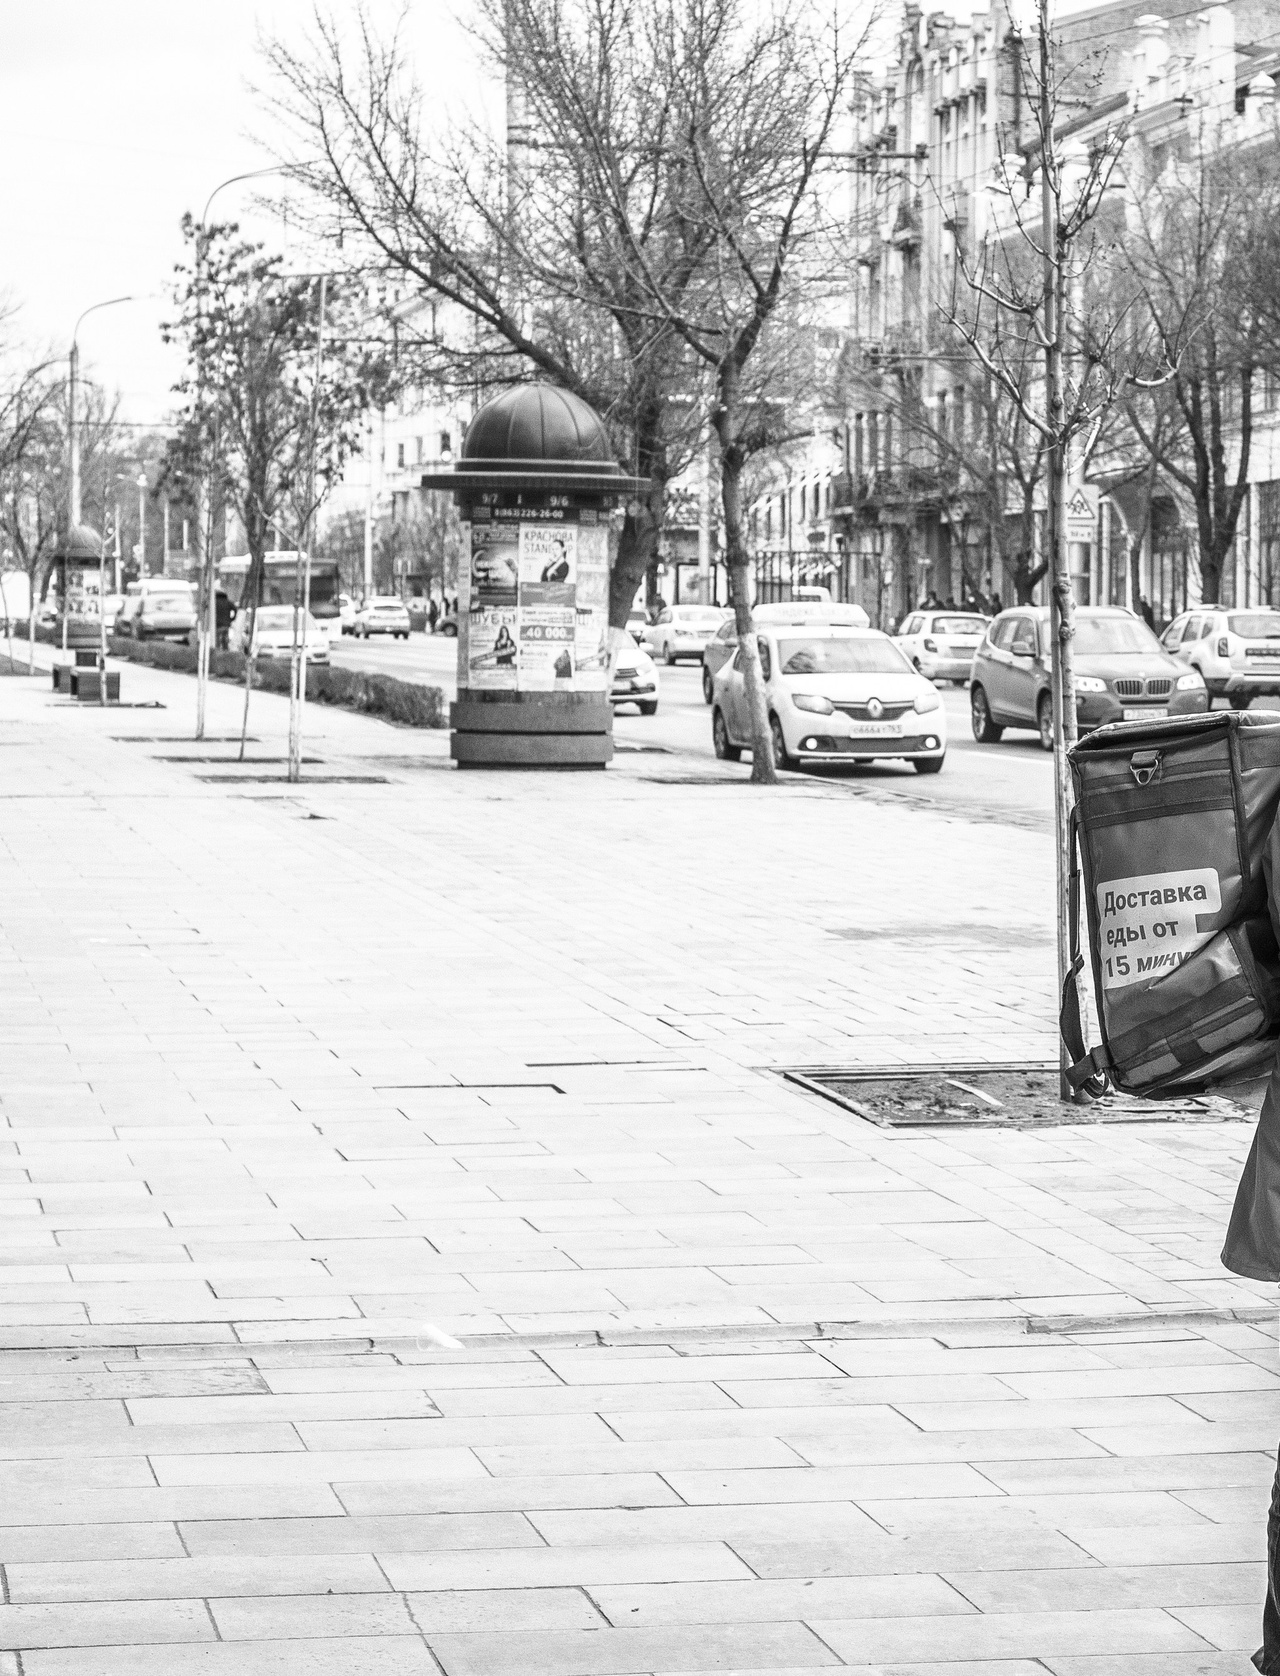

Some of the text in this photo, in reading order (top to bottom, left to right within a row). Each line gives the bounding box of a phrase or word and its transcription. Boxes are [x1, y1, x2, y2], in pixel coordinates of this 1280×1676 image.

[524, 530, 573, 543] КРАСНОВА
[1104, 883, 1208, 918] Доставка
[1106, 921, 1179, 948] еды от
[1105, 951, 1195, 978] 15 мину
